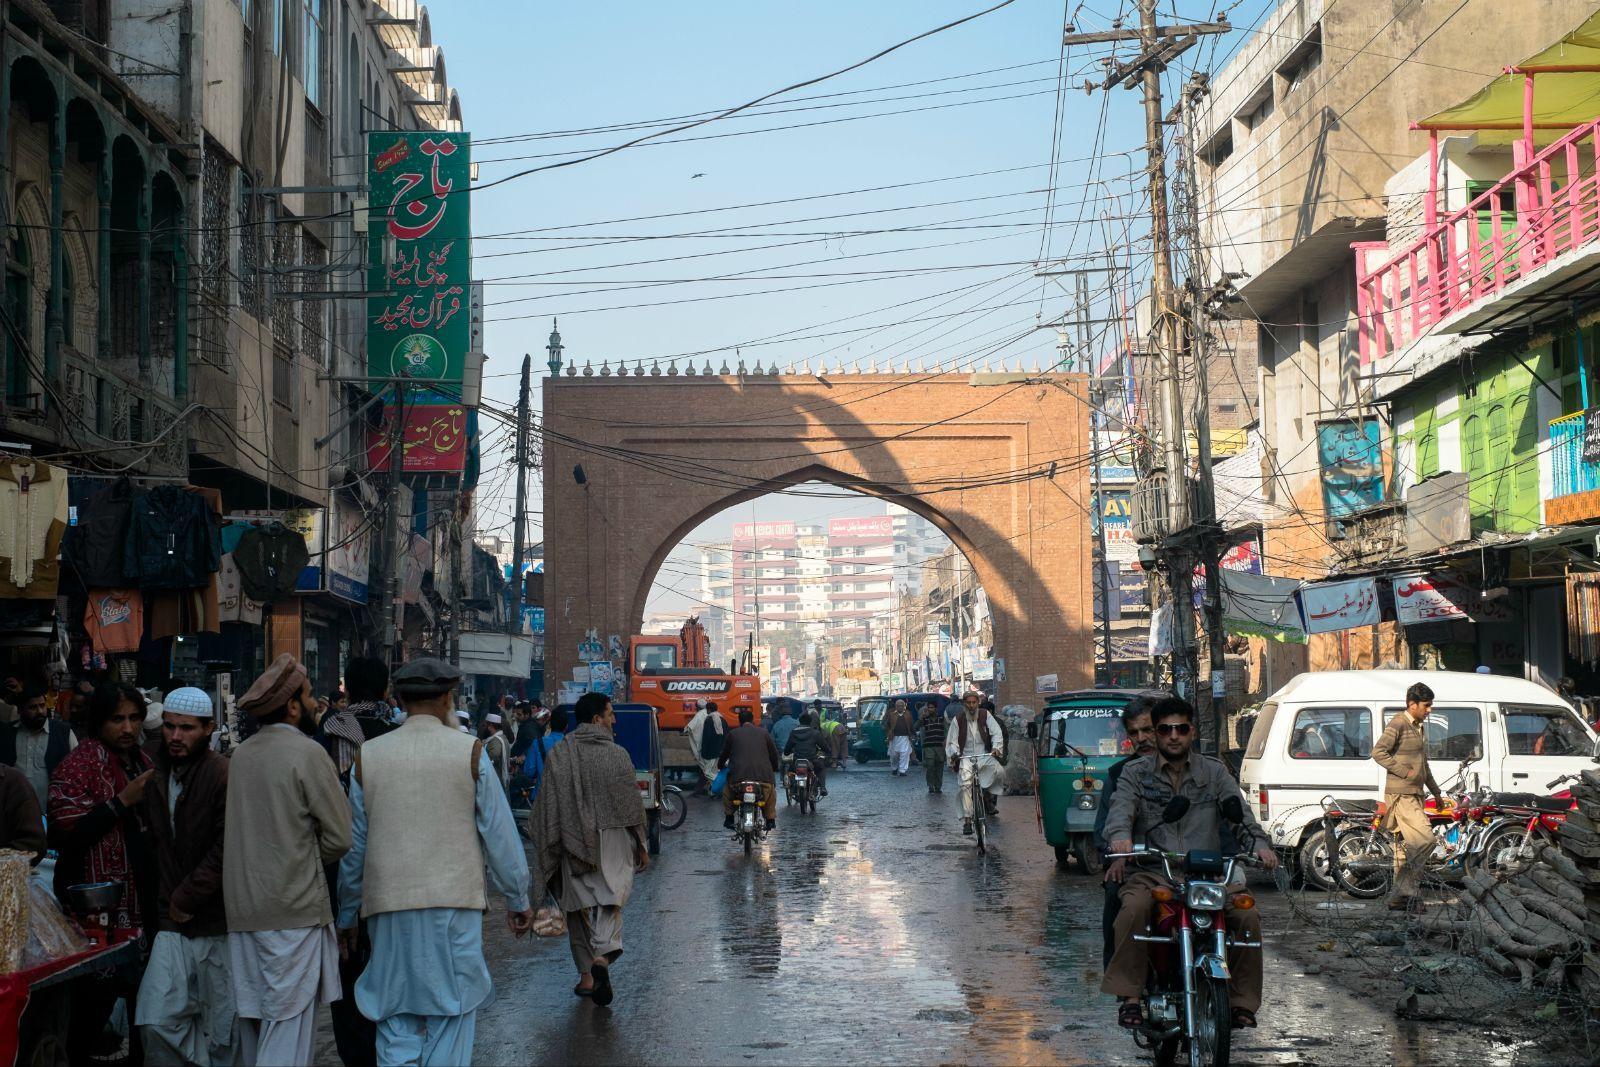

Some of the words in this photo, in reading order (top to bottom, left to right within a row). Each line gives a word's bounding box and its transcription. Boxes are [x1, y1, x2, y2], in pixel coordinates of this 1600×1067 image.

[387, 138, 458, 240] تاج
[374, 294, 414, 330] مجید
[410, 286, 464, 330] قرآن
[434, 409, 463, 453] تاج
[667, 681, 727, 691] DOOSAN
